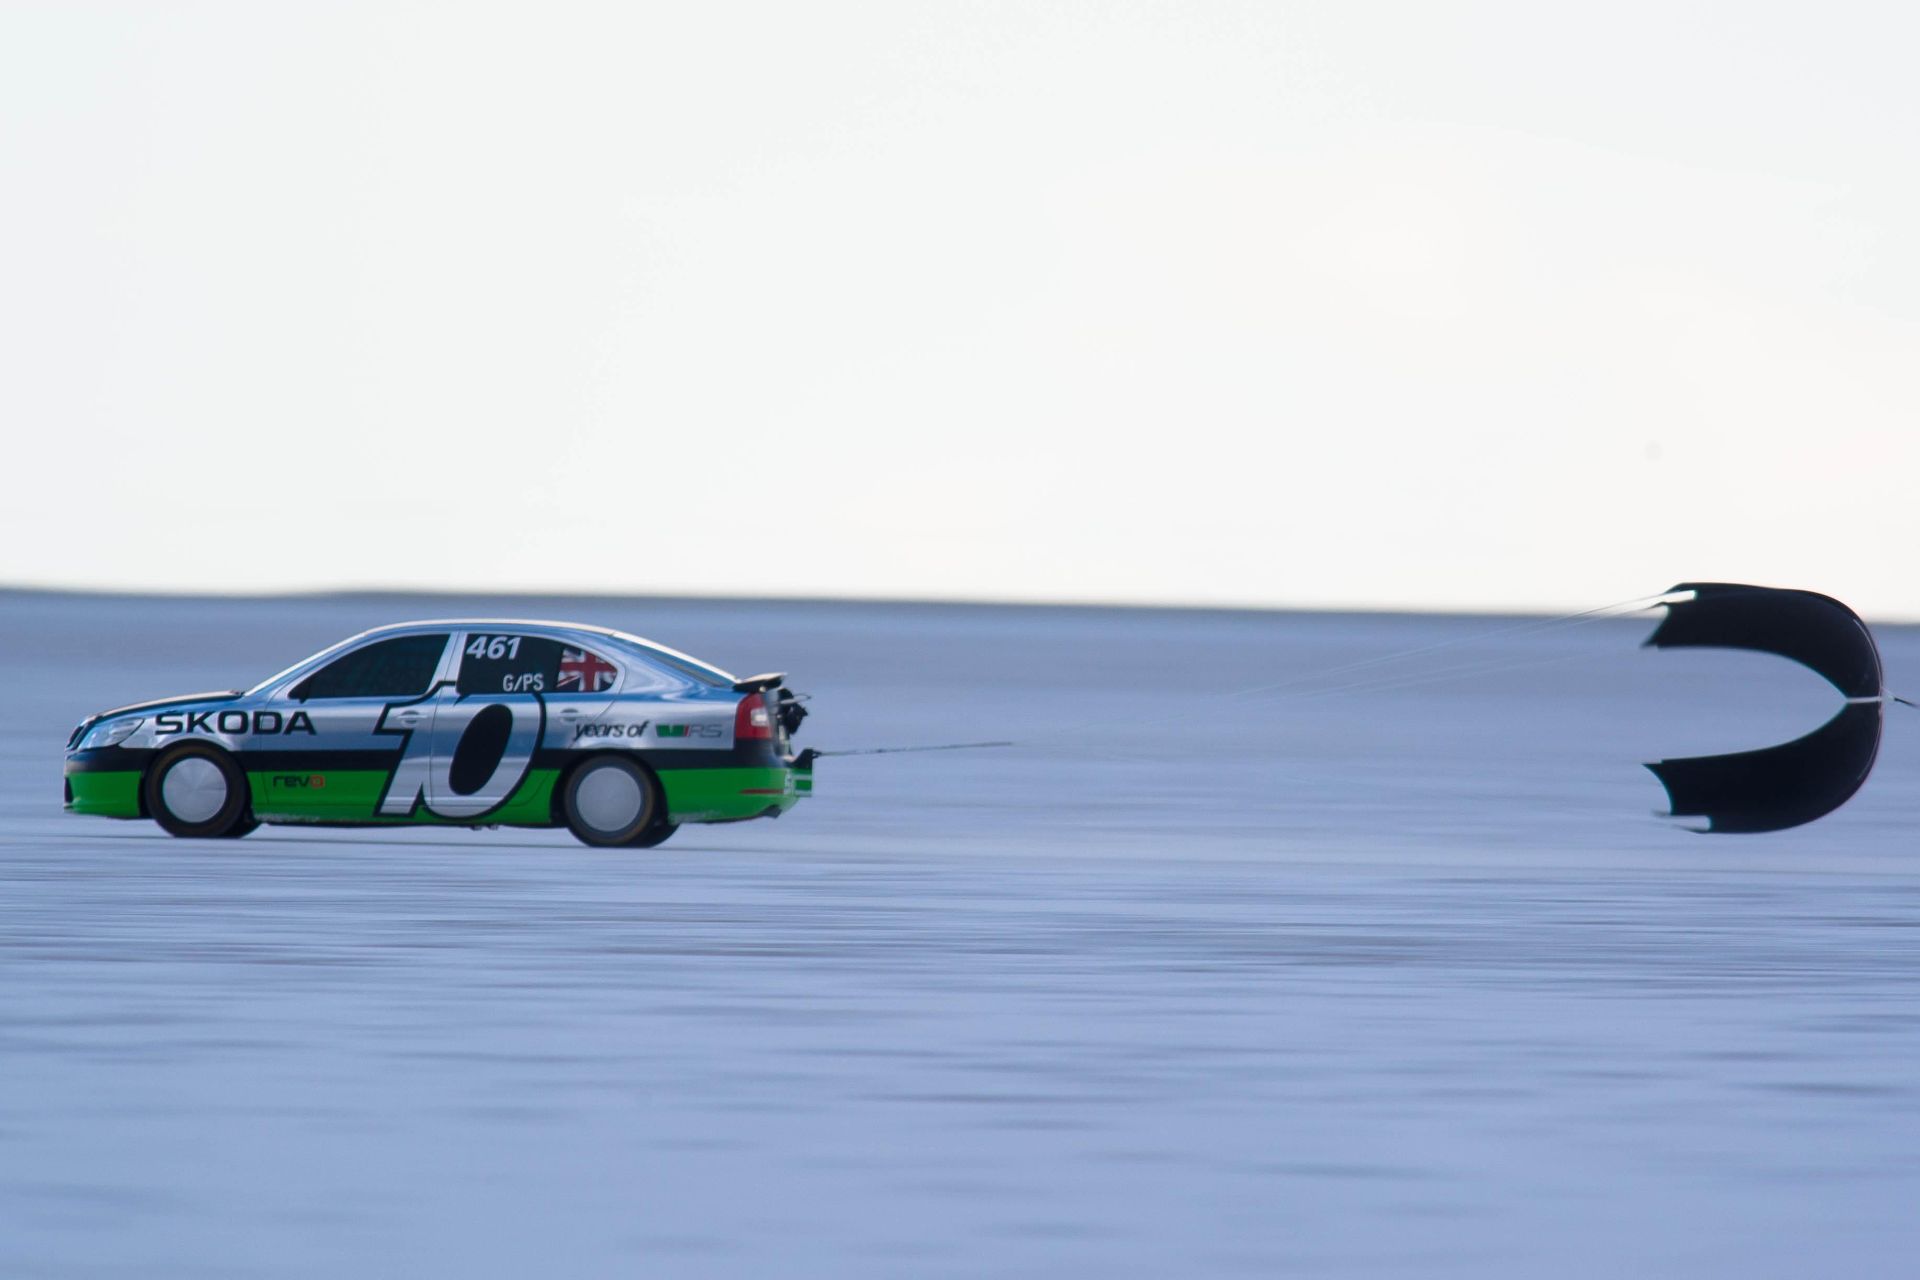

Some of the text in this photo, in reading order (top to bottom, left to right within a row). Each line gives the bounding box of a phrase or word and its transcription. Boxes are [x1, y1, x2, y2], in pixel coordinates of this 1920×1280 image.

[466, 636, 521, 660] 461
[503, 673, 544, 692] G/PS
[574, 724, 625, 742] years
[627, 720, 650, 738] of
[372, 681, 547, 820] 10
